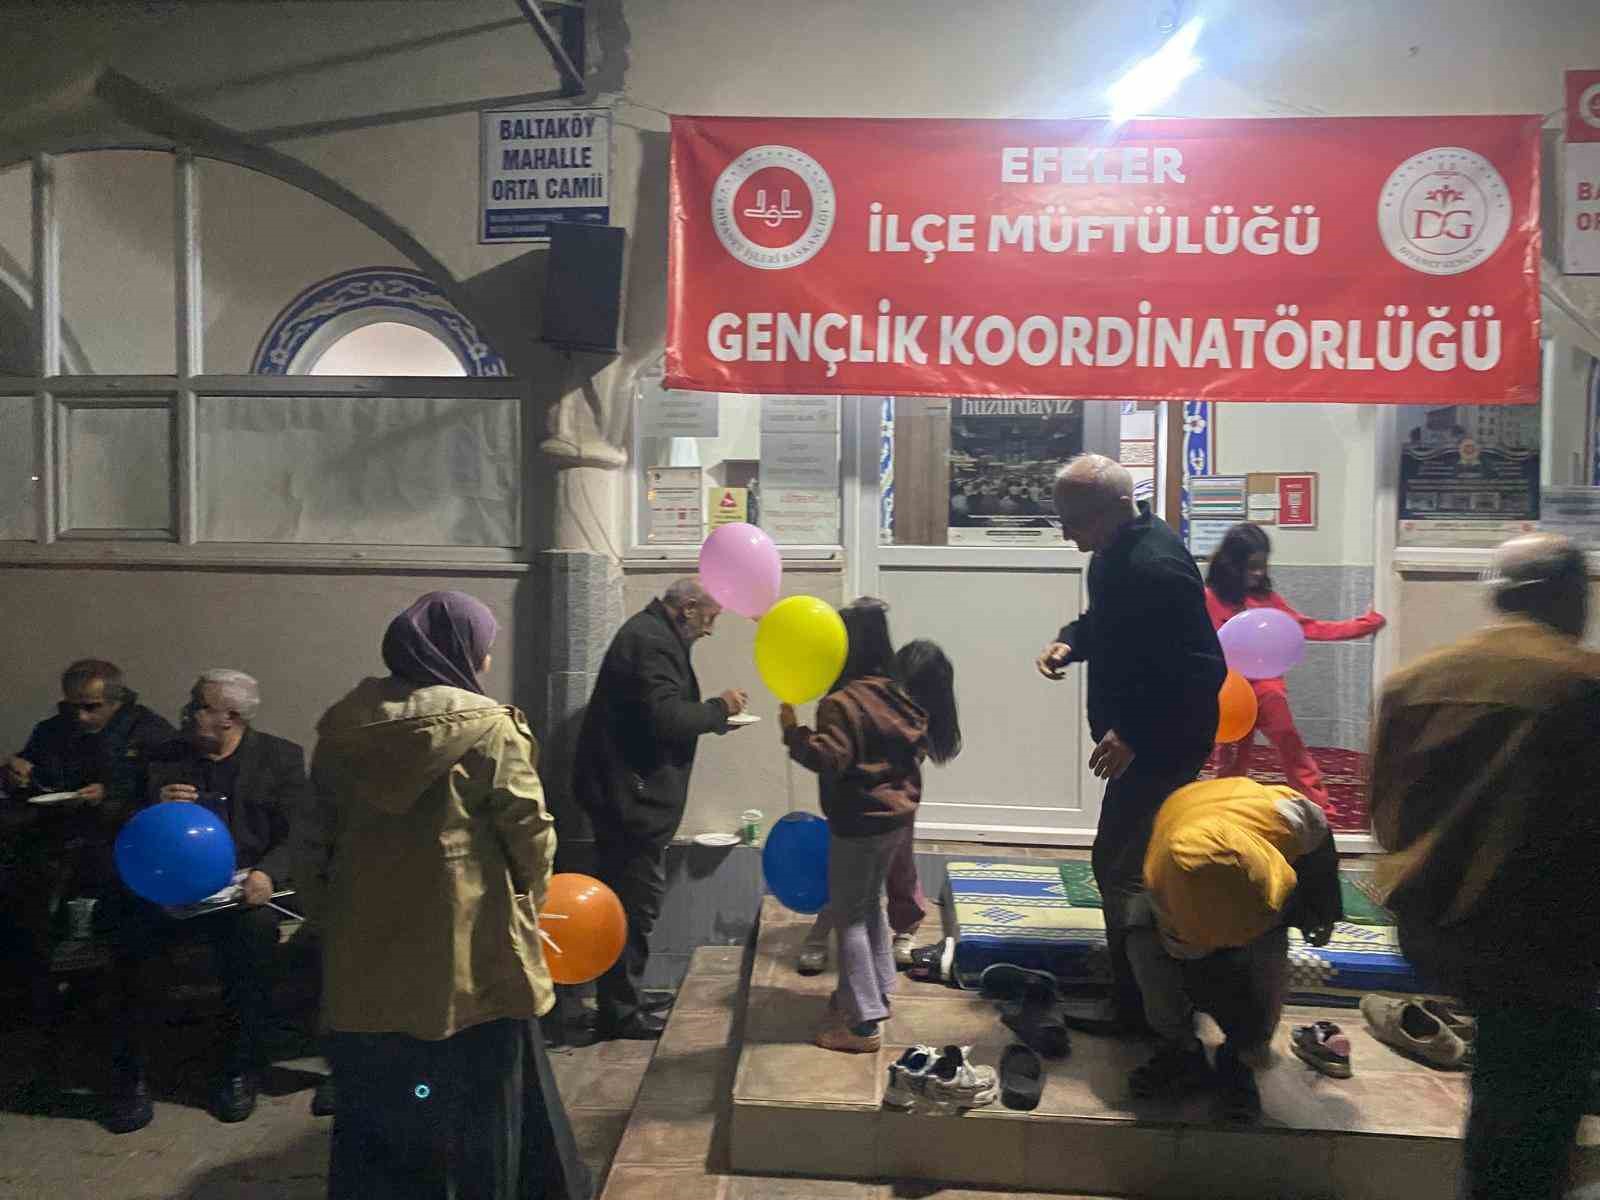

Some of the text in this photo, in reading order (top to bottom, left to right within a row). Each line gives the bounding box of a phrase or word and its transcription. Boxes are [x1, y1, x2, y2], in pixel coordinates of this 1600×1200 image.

[500, 113, 595, 141] BALTAKÖY
[502, 147, 592, 170] MAHALLE
[1001, 147, 1186, 184] EFELER
[491, 173, 603, 201] ORTA CAMİİ
[868, 202, 1321, 264] İLÇE MÜFTÜLÜĞÜ
[708, 300, 1501, 377] GENÇLİK KOORDİNATÖRLÜĞÜ
